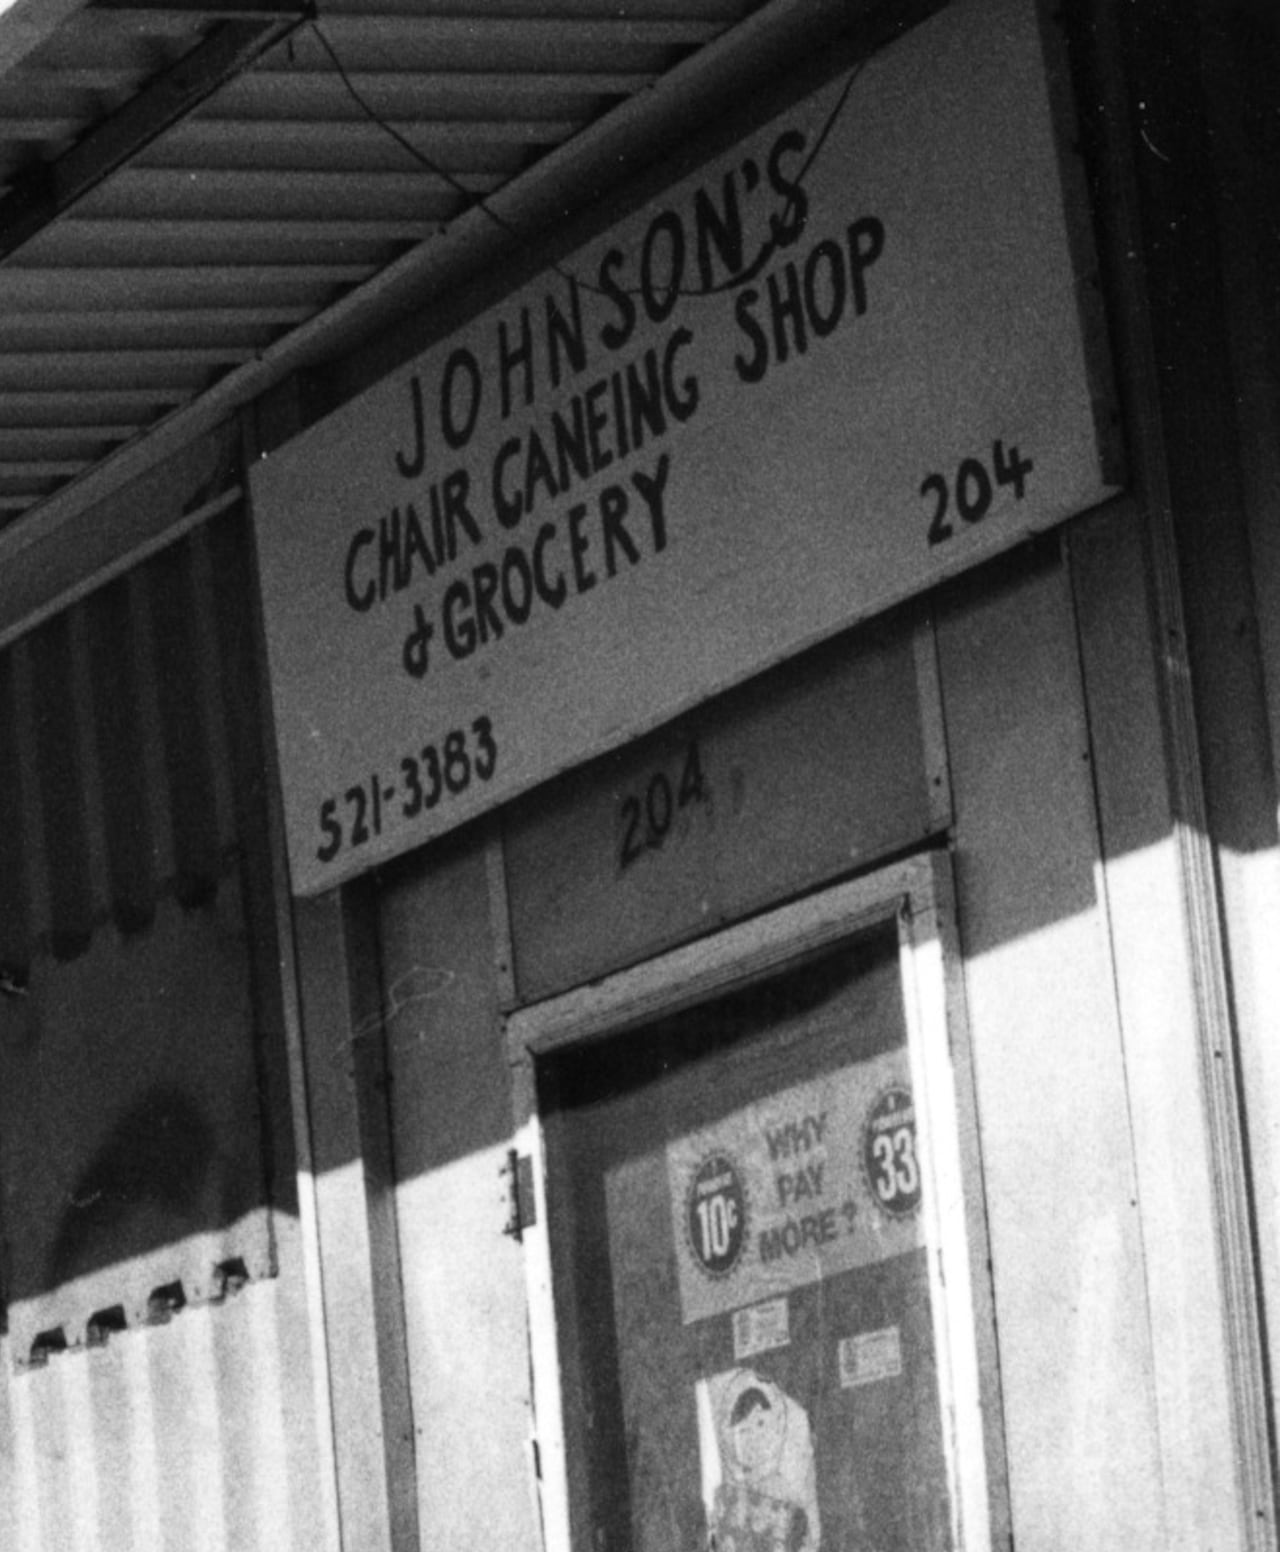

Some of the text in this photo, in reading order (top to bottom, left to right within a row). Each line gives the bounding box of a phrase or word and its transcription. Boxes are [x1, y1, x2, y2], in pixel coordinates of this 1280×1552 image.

[395, 129, 809, 479] JOHNSON'S
[344, 215, 885, 613] CHAIR CANEING SHOP
[442, 452, 670, 661] GROCERY
[919, 438, 1034, 548] 204
[316, 714, 498, 863] 521-3383
[619, 737, 711, 870] 204
[765, 1111, 828, 1162] WHY
[777, 1162, 825, 1208] PAY
